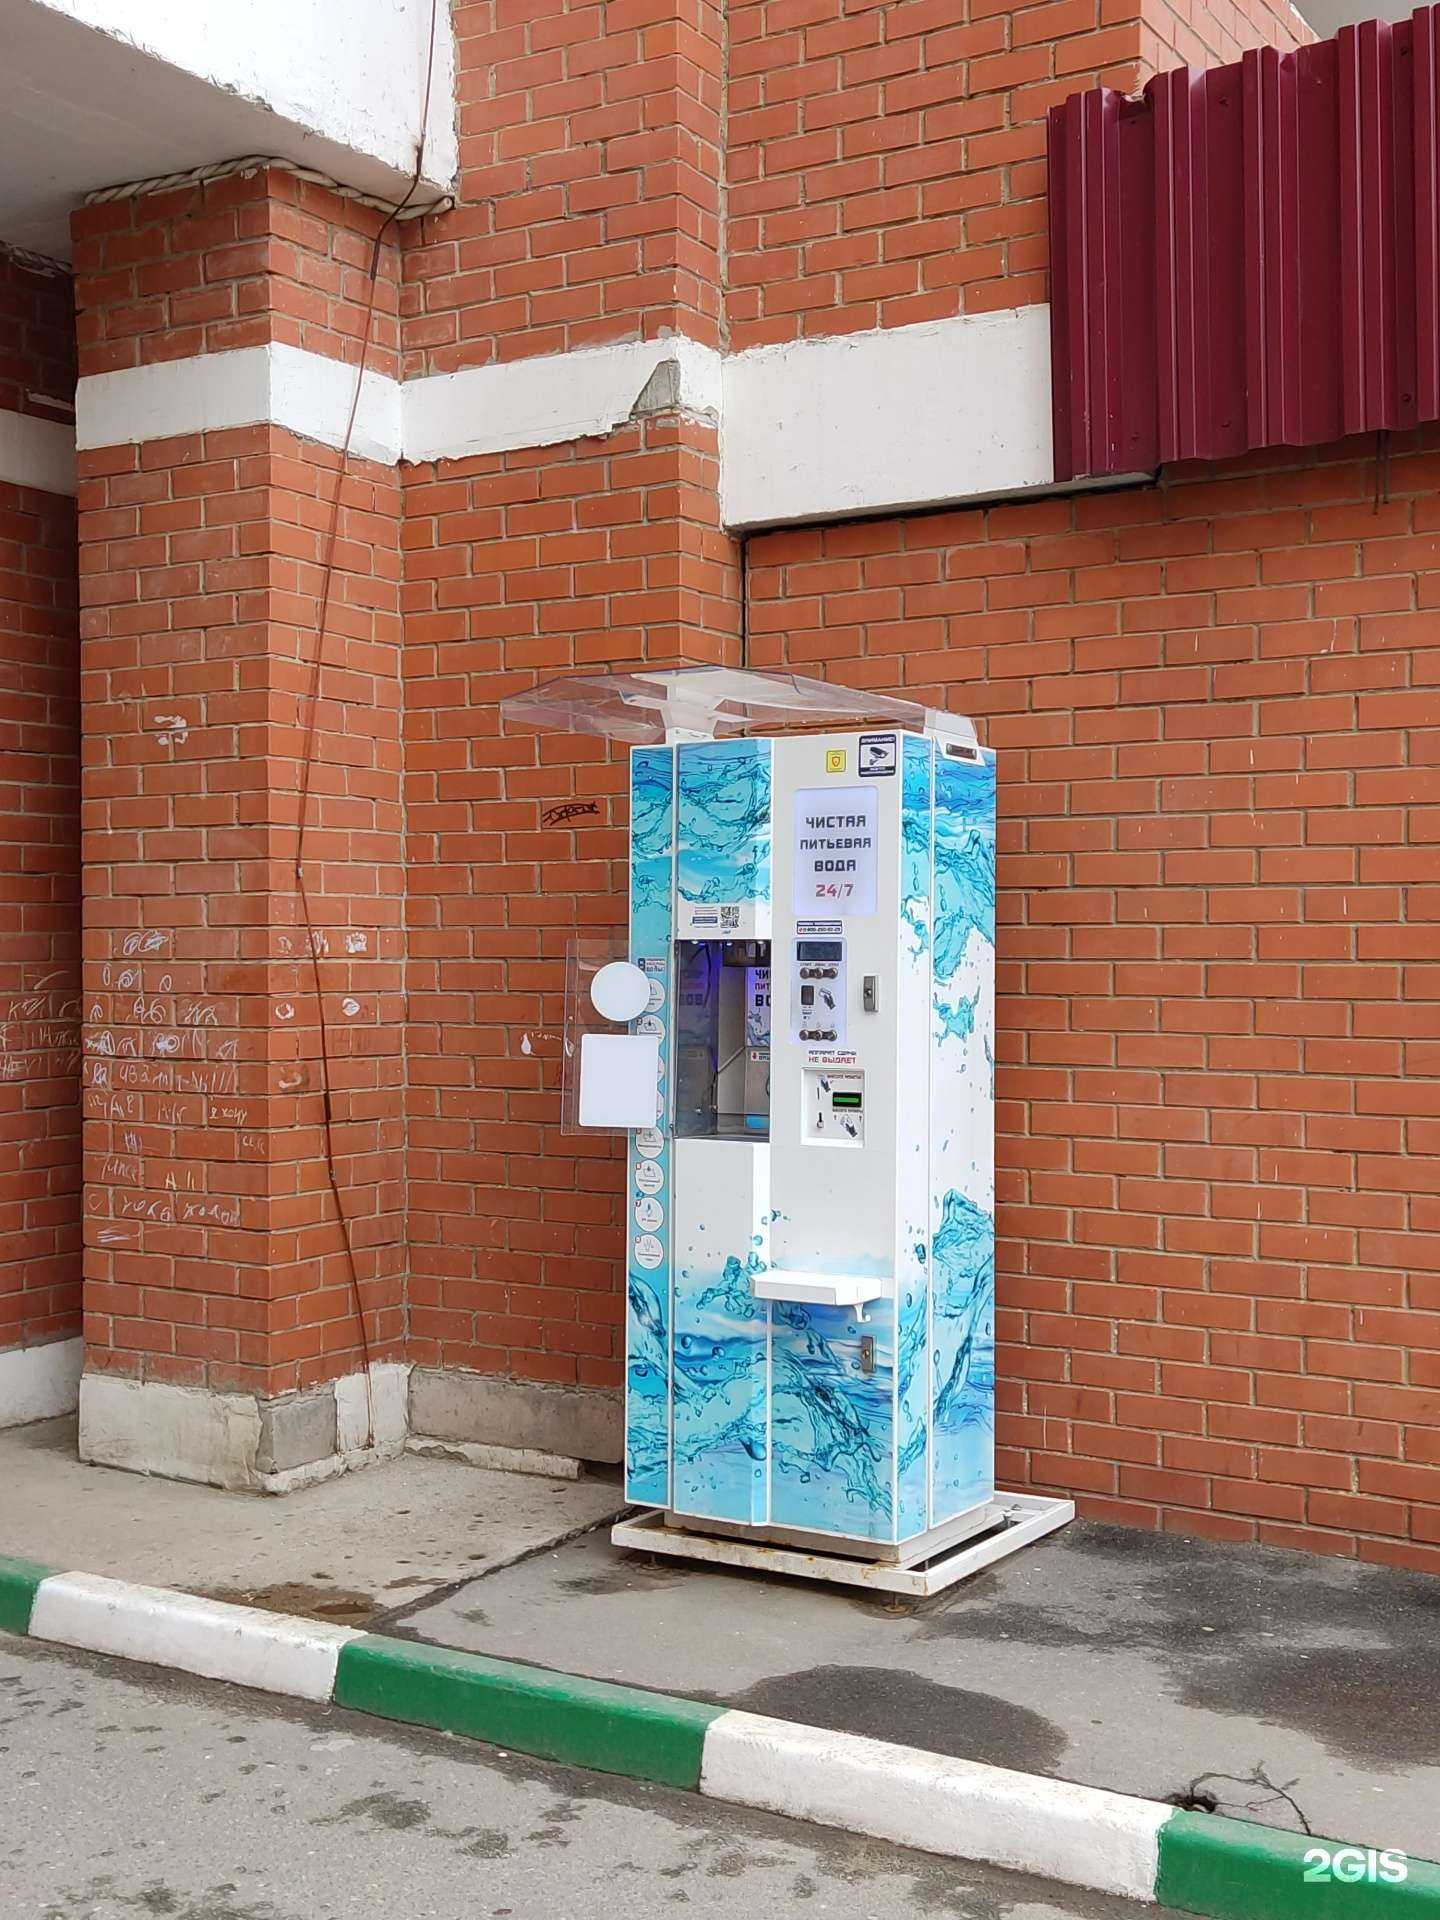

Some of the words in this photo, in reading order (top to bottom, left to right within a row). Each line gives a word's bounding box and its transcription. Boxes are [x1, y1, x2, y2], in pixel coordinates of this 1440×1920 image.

[805, 815, 866, 828] ЧИСТАЯ
[800, 838, 871, 850] ПИТЬЕВАЯ
[814, 860, 856, 872] ВОДА
[815, 884, 854, 899] 24/7
